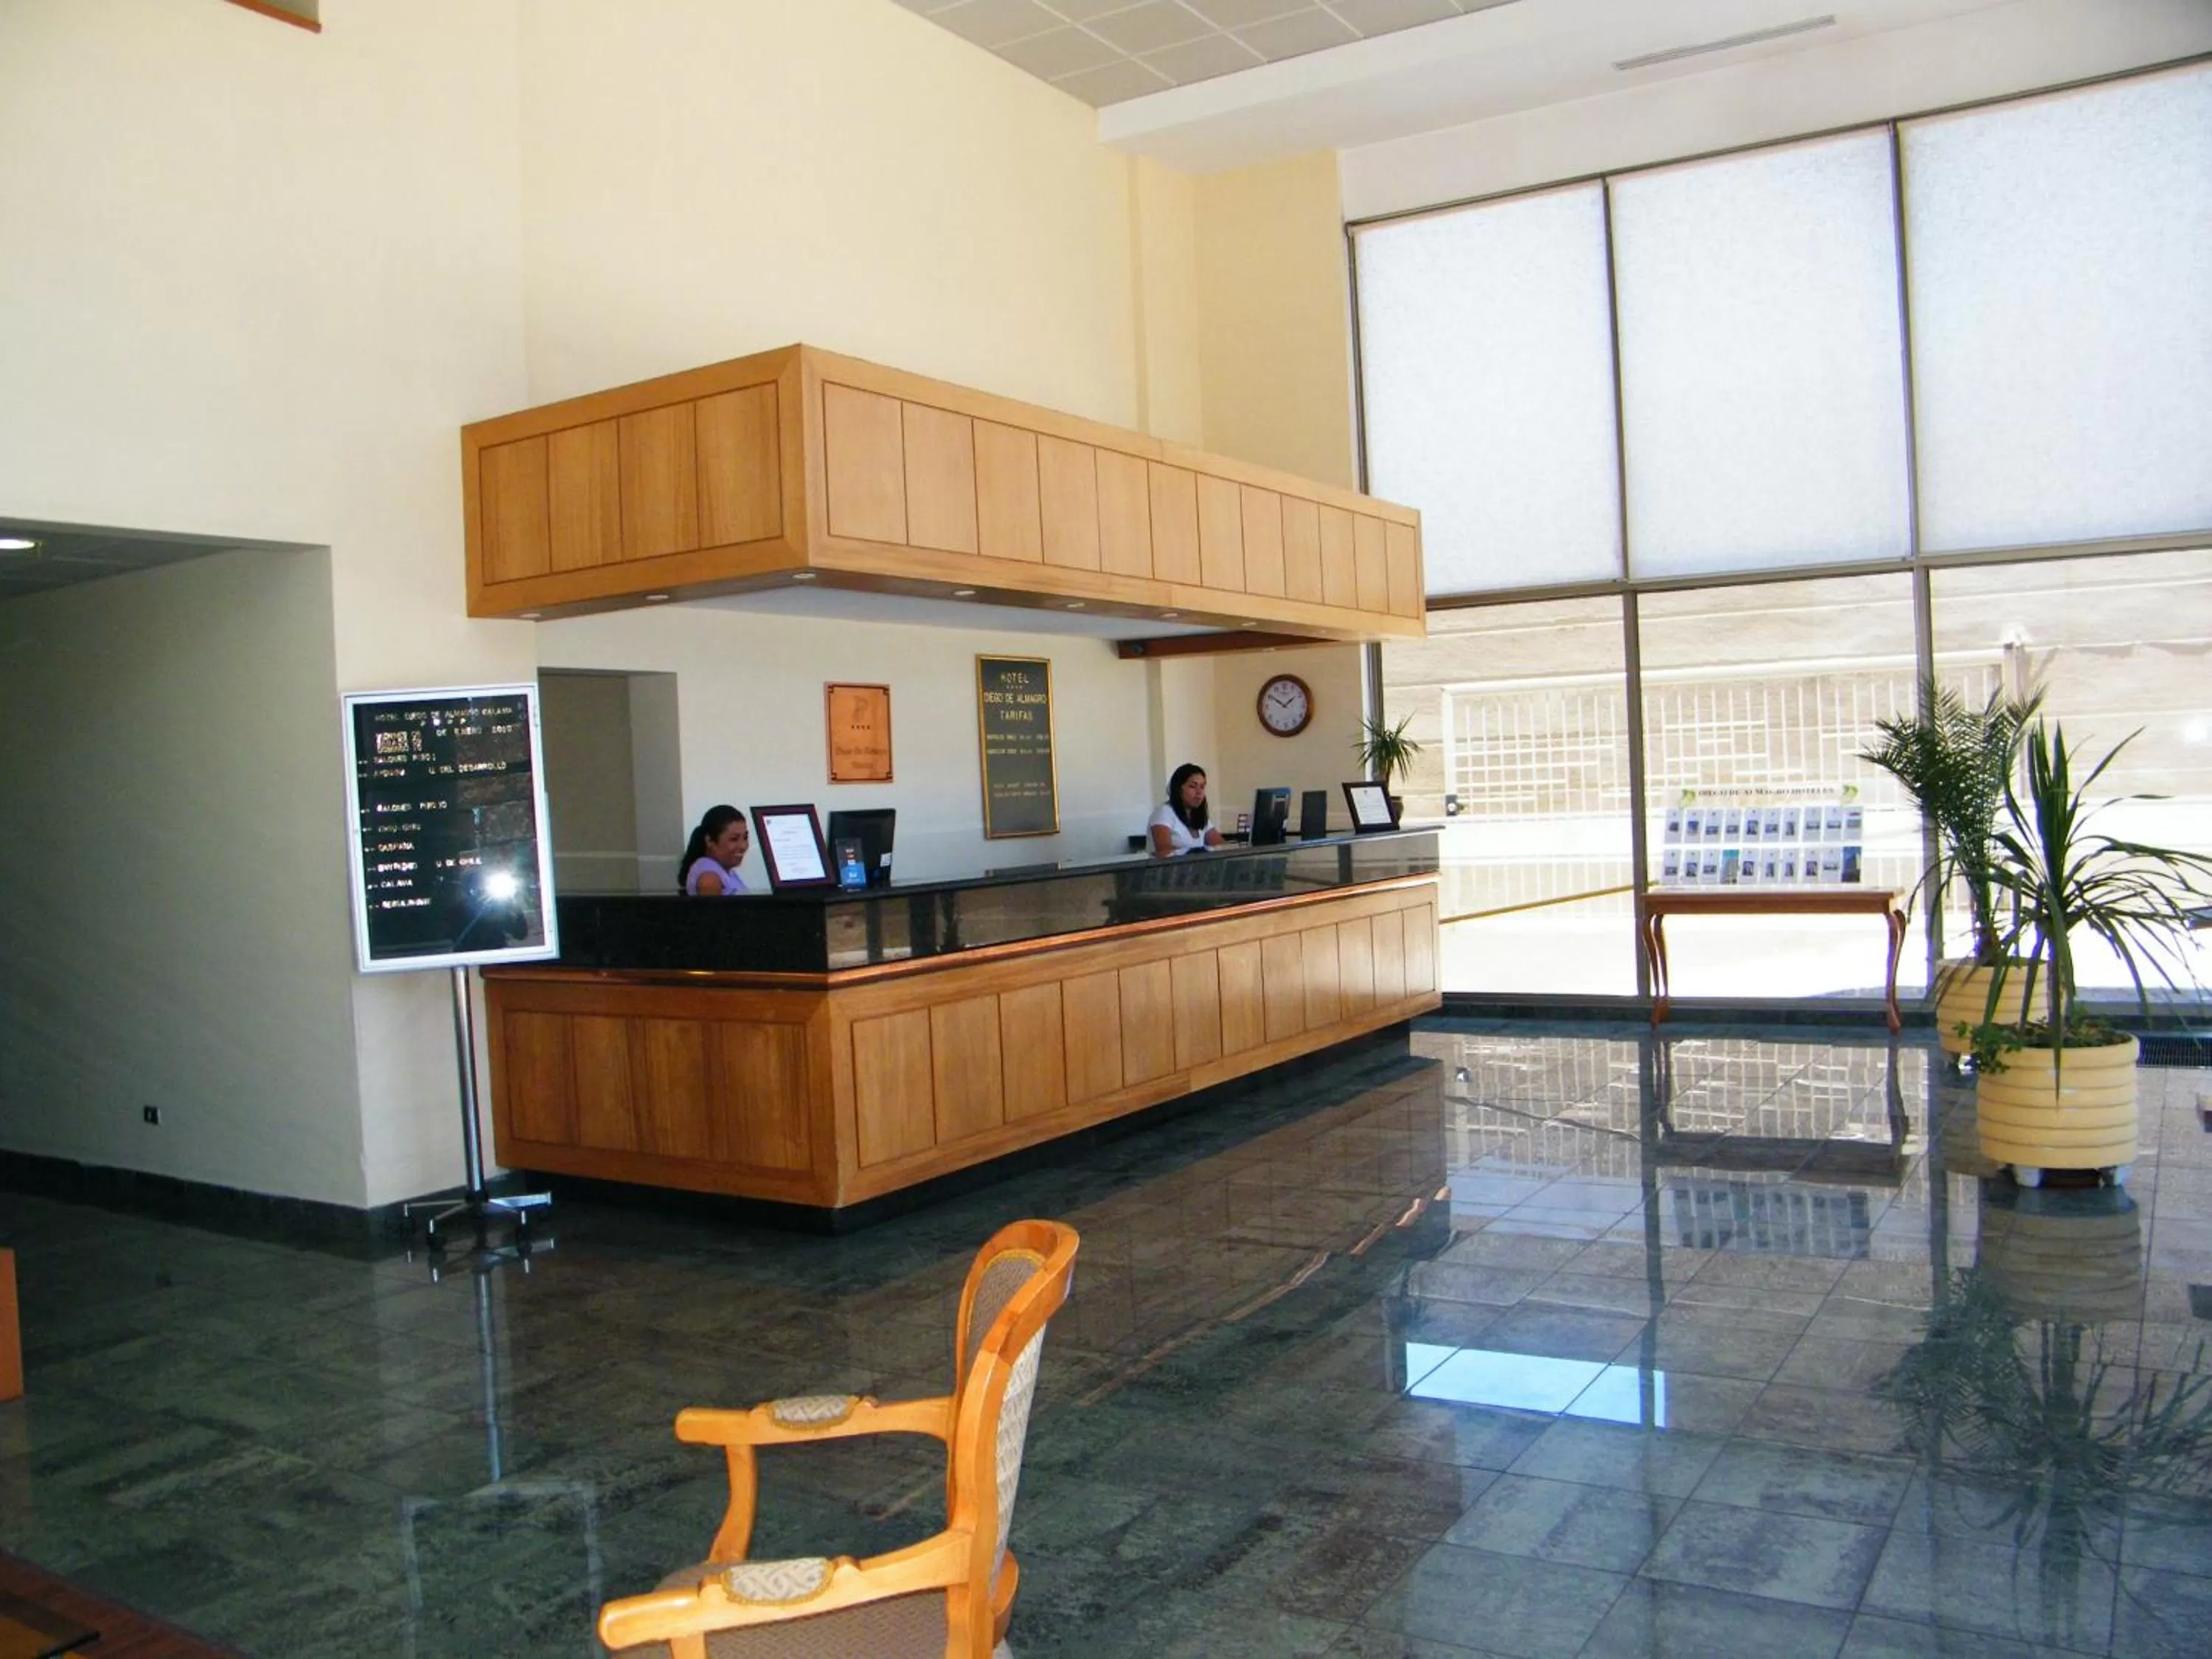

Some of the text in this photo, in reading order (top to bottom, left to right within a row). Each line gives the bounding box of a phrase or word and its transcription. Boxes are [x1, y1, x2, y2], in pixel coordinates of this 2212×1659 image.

[1001, 672, 1030, 684] HOTEL
[1005, 692, 1015, 704] DE
[1000, 710, 1033, 720] TARIFAS
